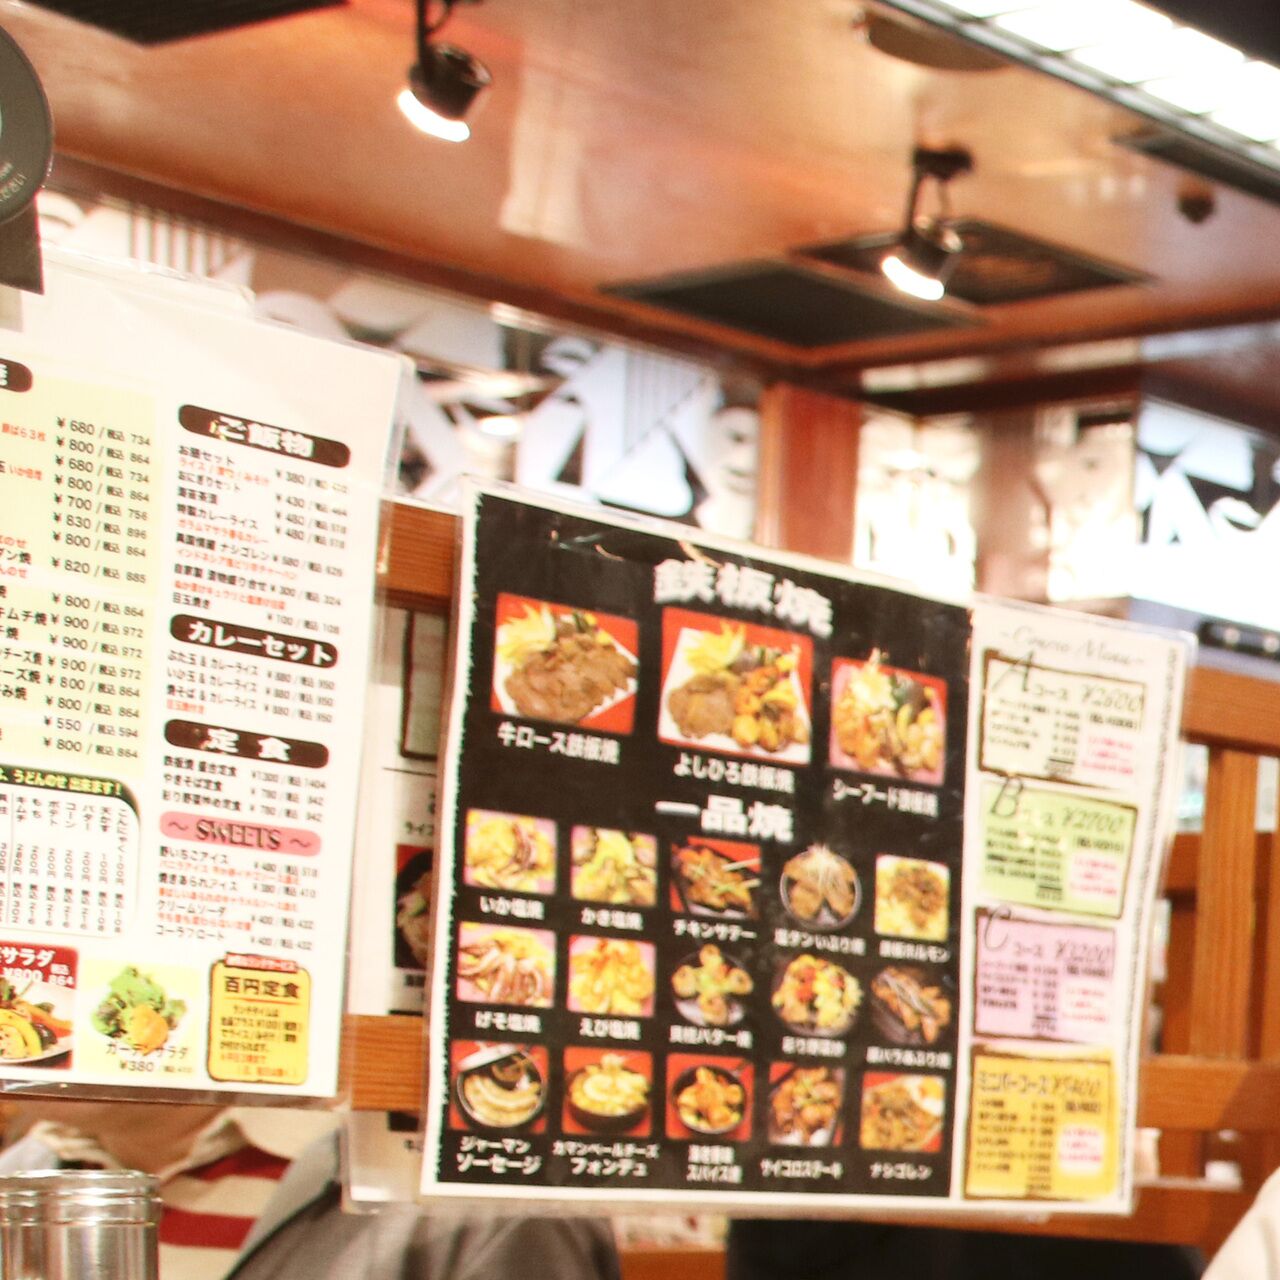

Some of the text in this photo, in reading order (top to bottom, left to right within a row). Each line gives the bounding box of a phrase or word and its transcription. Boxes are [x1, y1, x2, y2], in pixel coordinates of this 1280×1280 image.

[70, 420, 95, 435] 680
[130, 434, 150, 446] 734
[217, 415, 315, 458] ご飯物
[69, 439, 94, 454] 800
[130, 453, 150, 464] 864
[68, 458, 94, 472] 680
[129, 471, 149, 483] 734
[67, 477, 92, 491] 800
[130, 491, 149, 502] 864
[67, 496, 92, 510] 700
[129, 508, 148, 520] 756
[66, 515, 91, 529] 830
[127, 527, 147, 539] 896
[65, 533, 90, 548] 800
[126, 546, 146, 557] 864
[64, 560, 90, 574] 820
[126, 571, 146, 583] 885
[65, 595, 90, 609] 800
[124, 606, 144, 617] 864
[654, 558, 834, 638] 鉄板焼
[64, 616, 89, 629] 900
[123, 626, 143, 638] 972
[62, 637, 88, 650] 900
[122, 647, 142, 658] 972
[188, 621, 333, 665] カレーセット
[61, 659, 86, 672] 900
[120, 668, 141, 680] 972
[211, 658, 258, 676] カレーライス
[60, 677, 140, 697] 800 864
[210, 674, 257, 692] カレーライス
[58, 698, 139, 718] 800 864
[209, 692, 257, 710] カレーライス
[57, 718, 138, 738] 550 594
[57, 739, 138, 758] 800 864
[497, 721, 621, 765] 牛ロース鉄板焼
[673, 752, 795, 794] よしひろ鉄板焼
[990, 773, 1024, 818] B
[654, 794, 793, 842] 一品焼
[195, 818, 282, 850] SWEETS
[672, 919, 757, 942] チキンサテー
[0, 945, 55, 967] サラダ
[49, 974, 74, 986] 864
[225, 976, 300, 999] 百円定食
[119, 1060, 154, 1072] ¥380
[460, 1135, 532, 1154] ジャーマン
[552, 1139, 661, 1159] カマンベールチーズ
[456, 1153, 542, 1175] ソーセージ
[570, 1157, 649, 1177] フォンデュ
[760, 1158, 844, 1180] サイコロステーキ
[869, 1161, 933, 1180] ナシゴレン
